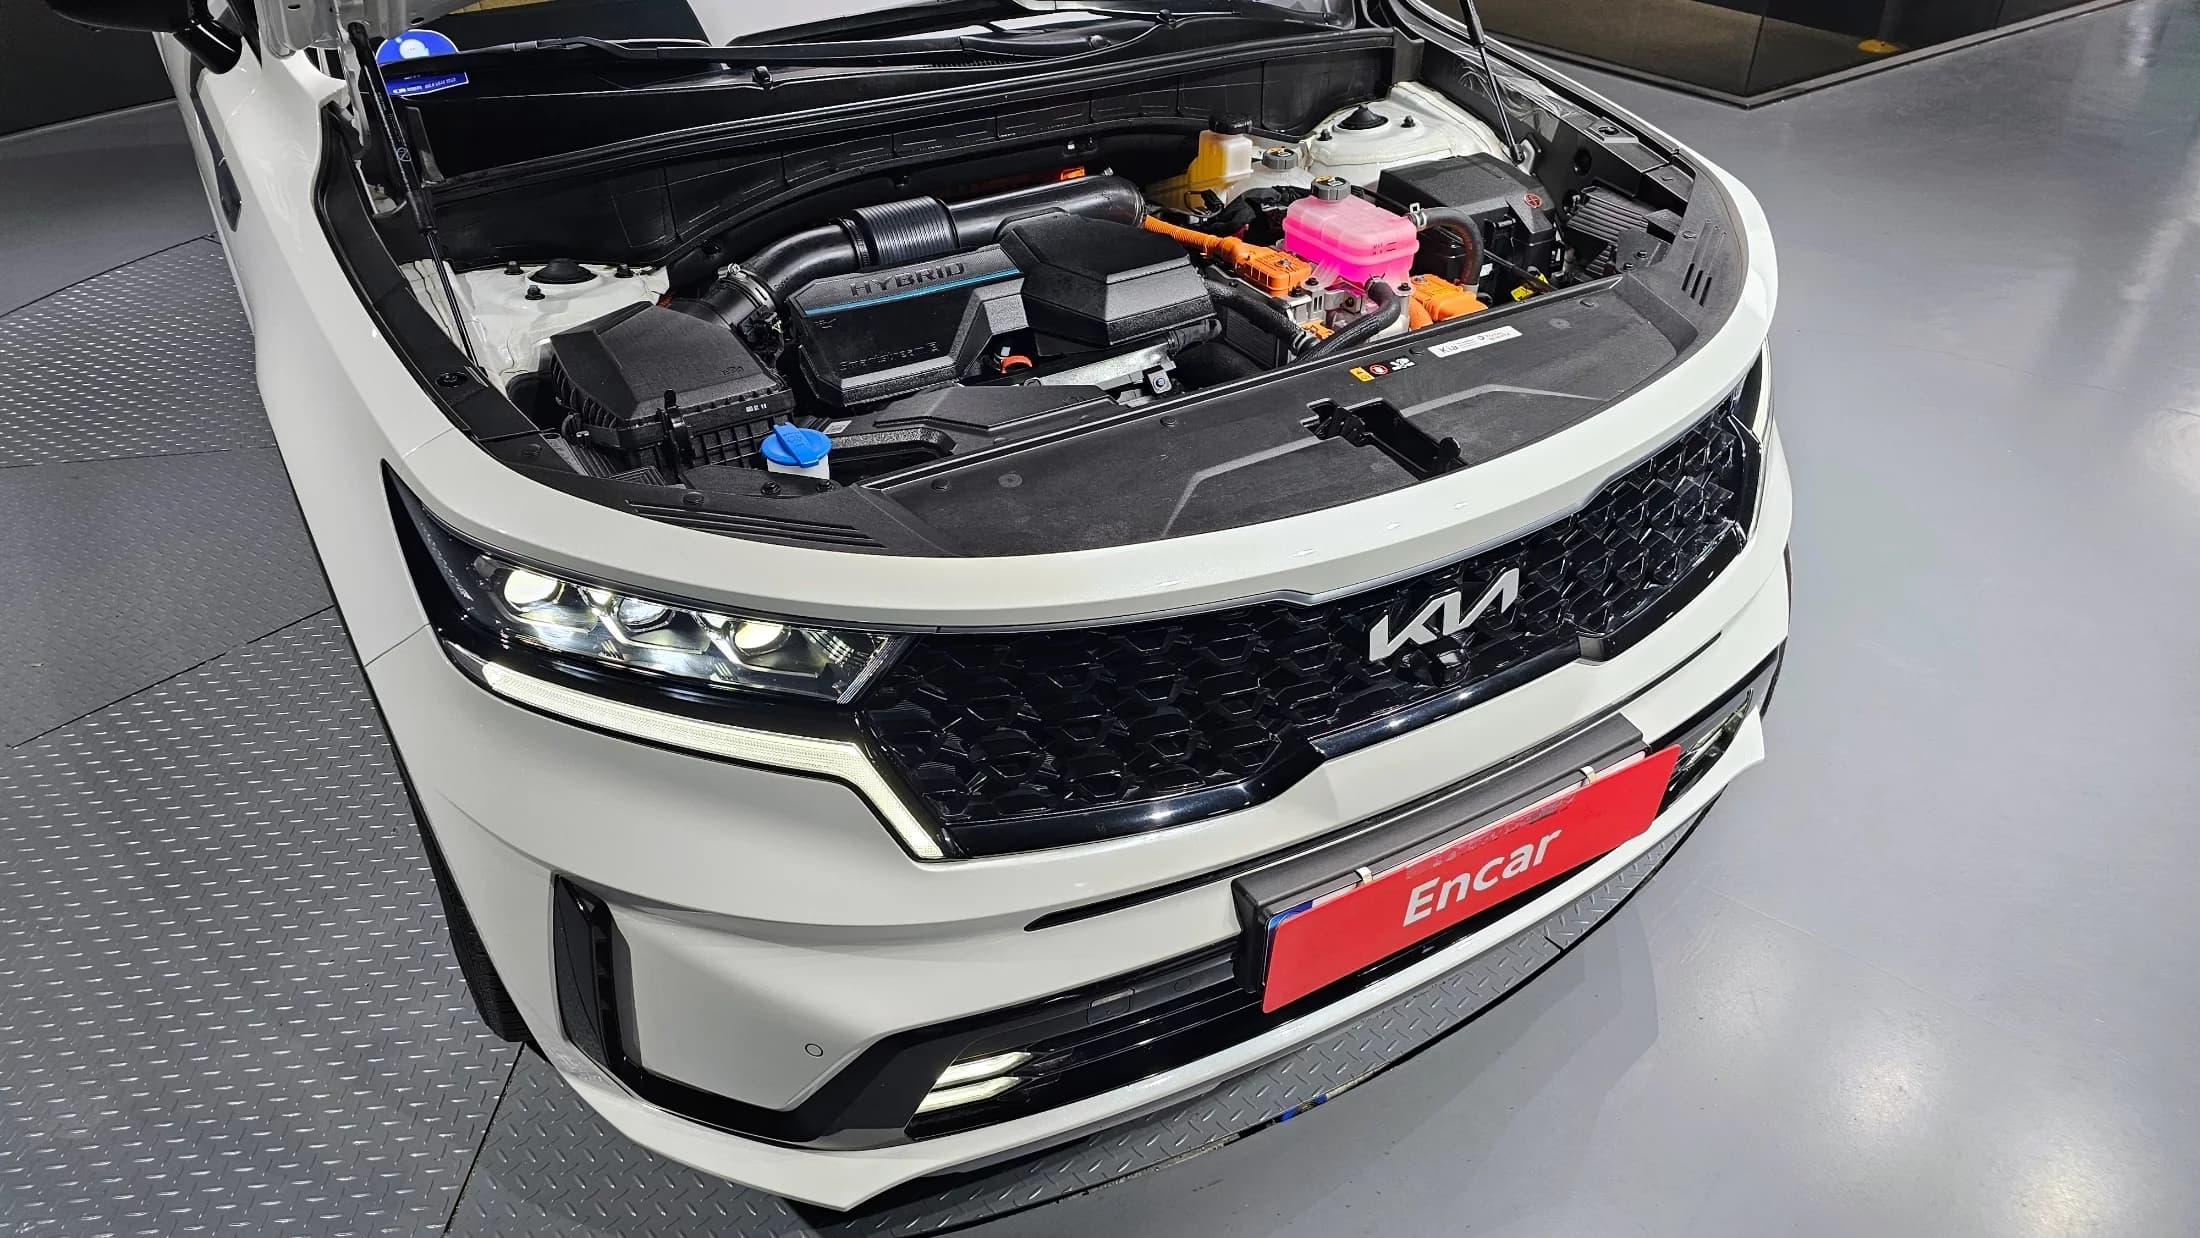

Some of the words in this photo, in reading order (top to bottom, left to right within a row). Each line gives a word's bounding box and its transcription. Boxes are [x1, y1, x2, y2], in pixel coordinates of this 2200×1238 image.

[850, 262, 965, 297] HYBRID
[1369, 567, 1520, 662] KIA
[1402, 829, 1563, 928] Encar
